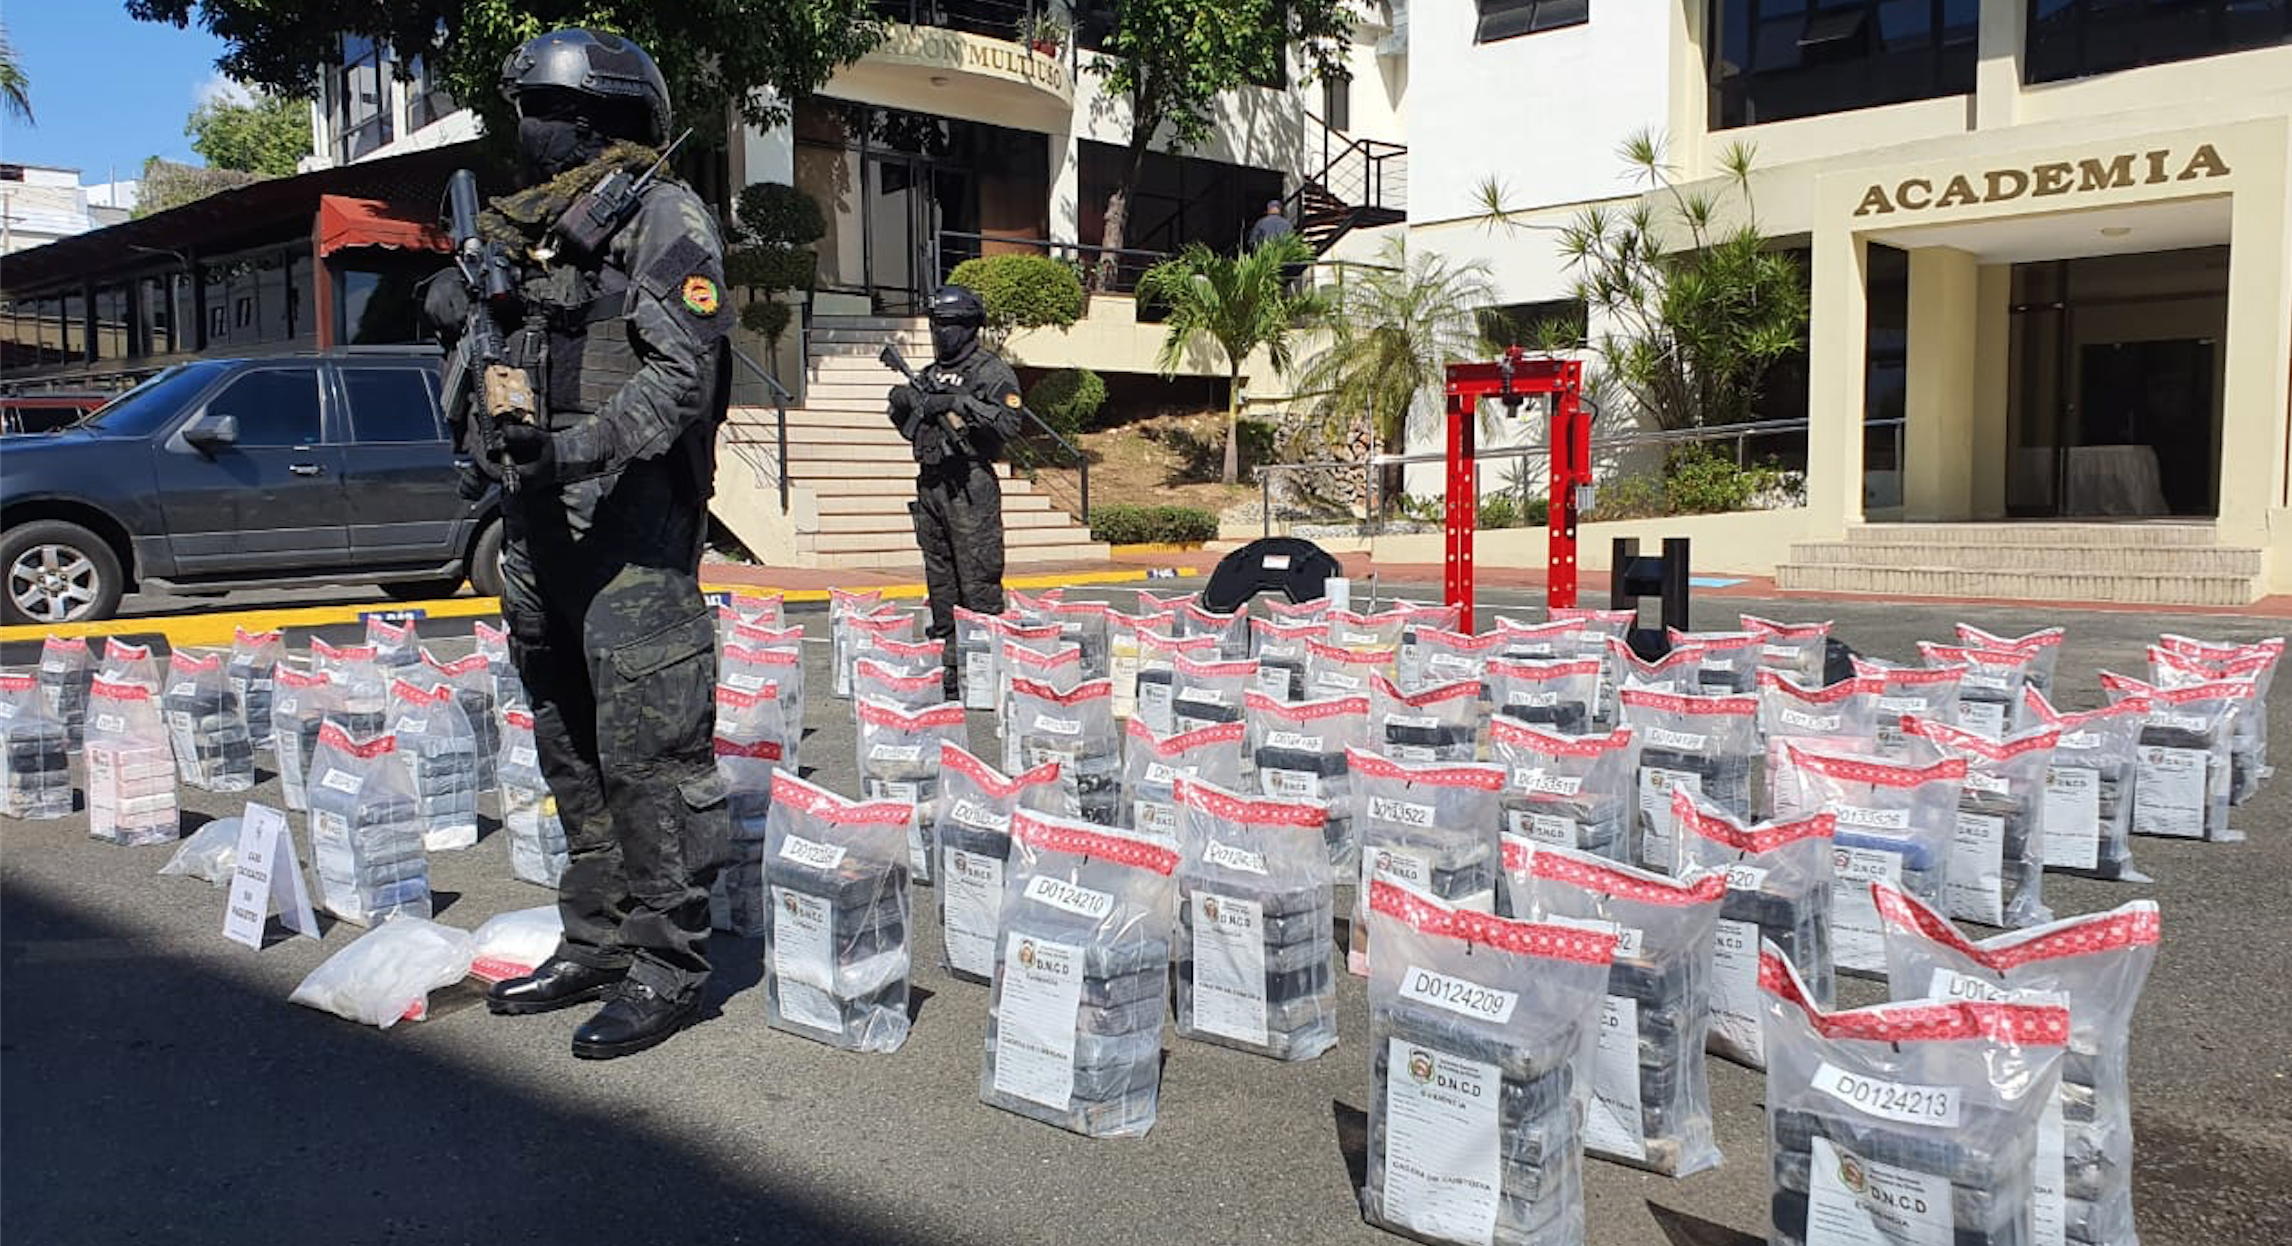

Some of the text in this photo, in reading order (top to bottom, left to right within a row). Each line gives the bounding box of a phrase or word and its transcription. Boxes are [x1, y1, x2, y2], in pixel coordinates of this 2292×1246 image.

[1853, 143, 2231, 217] ACADEMIA
[1036, 879, 1104, 912] D0124210
[1415, 972, 1505, 1015] D0124209
[1437, 1074, 1482, 1097] D.N.C.D
[1836, 1075, 1948, 1117] D0124213
[1869, 1184, 1927, 1214] D.N.C.D
